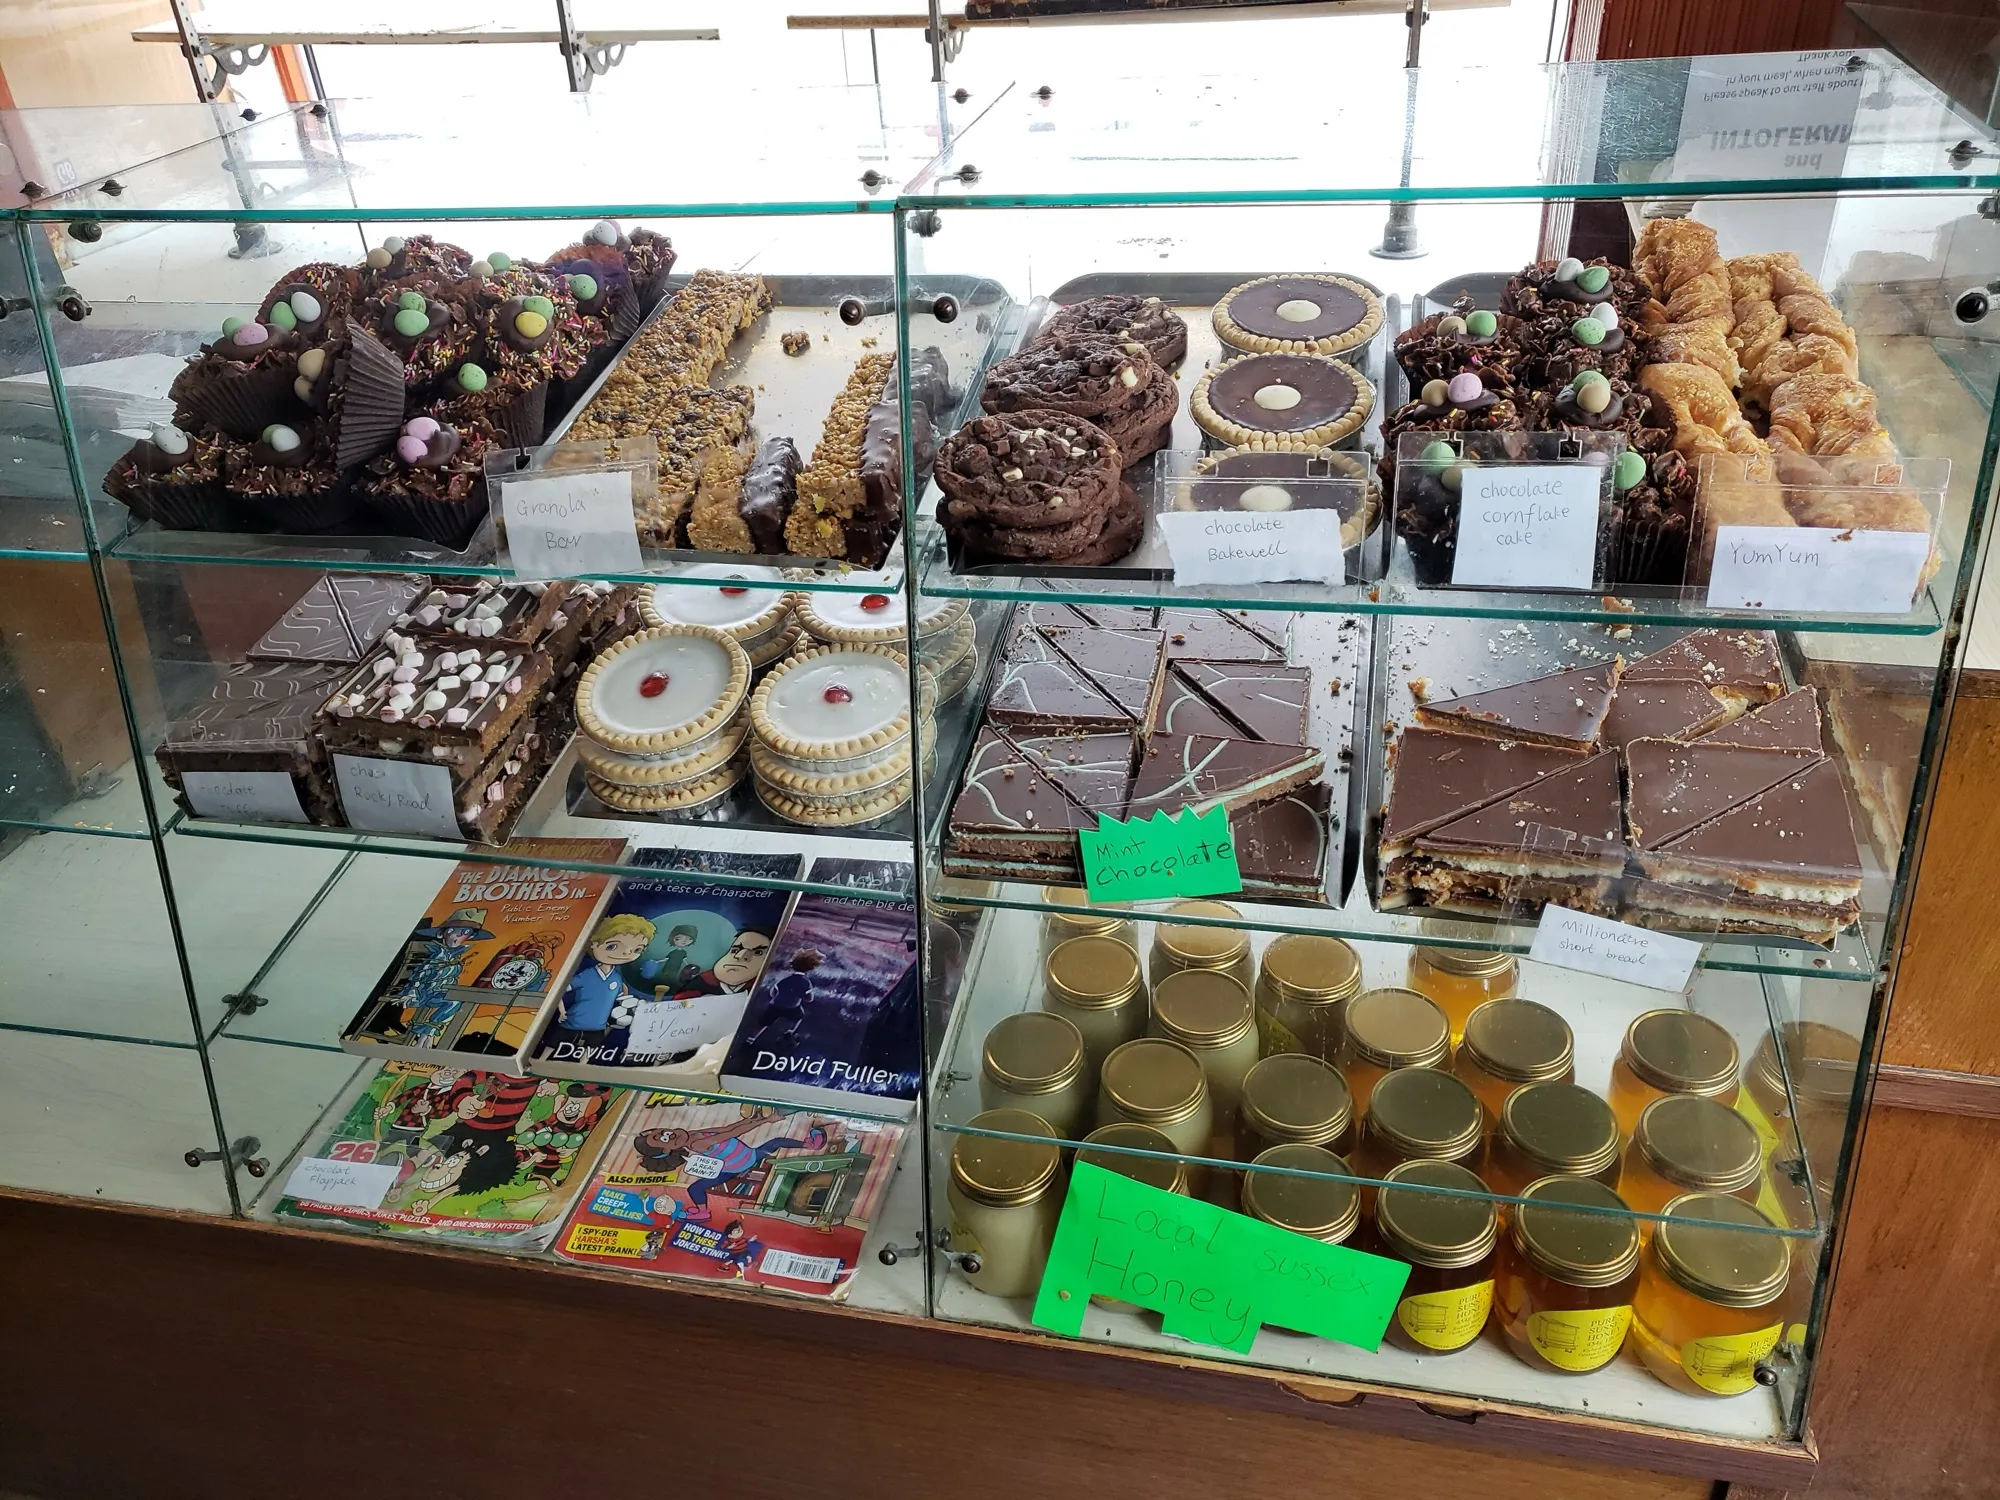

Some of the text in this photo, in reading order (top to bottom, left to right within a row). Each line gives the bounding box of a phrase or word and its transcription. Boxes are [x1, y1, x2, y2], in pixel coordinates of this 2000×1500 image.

[1480, 477, 1563, 499] chocolate
[517, 493, 587, 518] Granola
[1482, 502, 1571, 531] cornflake
[1204, 518, 1285, 536] chocolate
[1496, 529, 1533, 546] cake
[1207, 540, 1289, 563] Bakewell
[1096, 836, 1146, 862] Mint
[458, 871, 484, 884] THE
[454, 880, 570, 902] BROTHERS
[628, 881, 653, 891] and
[655, 883, 663, 892] a
[666, 884, 692, 893] test
[694, 883, 712, 896] of
[501, 902, 572, 914] Public Enemy
[824, 896, 849, 906] and
[851, 897, 873, 908] the
[876, 900, 896, 912] big
[503, 914, 570, 923] Number Two
[553, 1041, 615, 1064] David
[752, 1051, 900, 1086] David Fuller
[330, 1142, 377, 1163] 26
[607, 1175, 633, 1184] ALSO
[597, 1196, 630, 1209] CREEPY
[601, 1189, 626, 1200] MAKE
[610, 1206, 645, 1221] JELLIES!
[1098, 1179, 1224, 1254] Local
[453, 1220, 468, 1228] ONE
[683, 1223, 722, 1240] HOW BAD
[574, 1235, 618, 1245] HARSHA'S
[678, 1230, 719, 1247] DO THESE
[570, 1243, 639, 1256] LATEST PRANK!
[672, 1239, 730, 1260] JOKES STINK?
[1086, 1237, 1251, 1345] Honey
